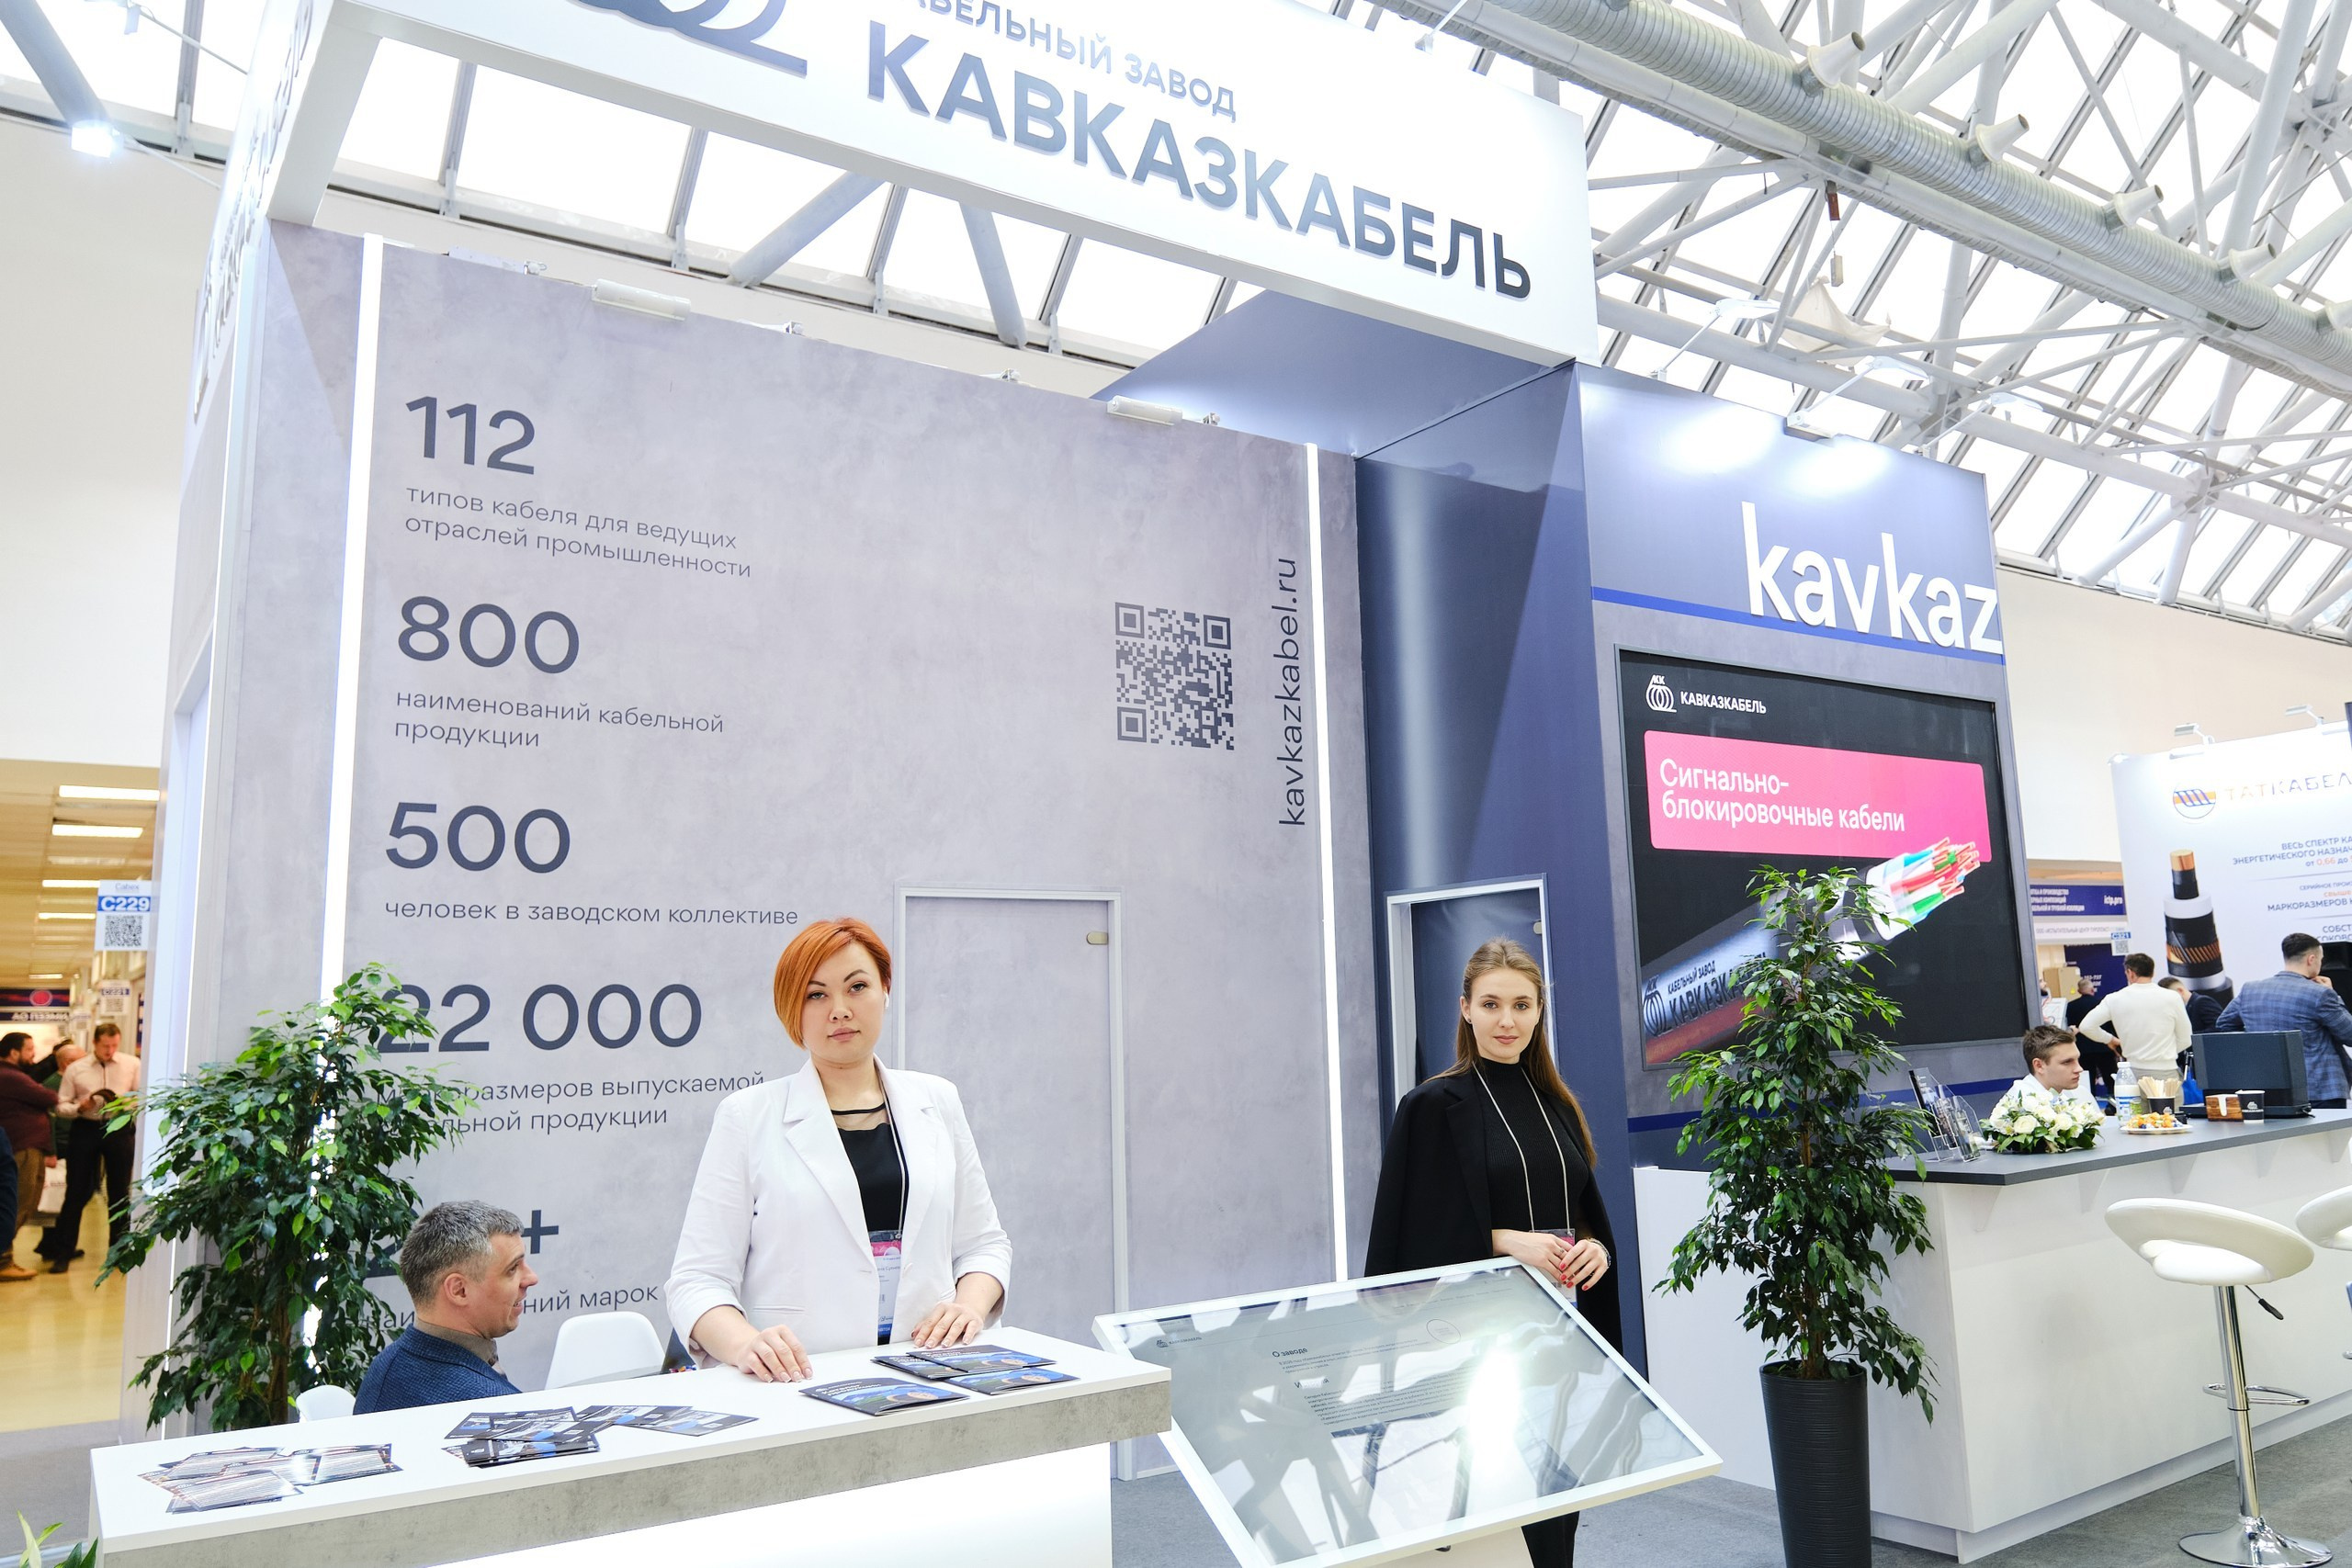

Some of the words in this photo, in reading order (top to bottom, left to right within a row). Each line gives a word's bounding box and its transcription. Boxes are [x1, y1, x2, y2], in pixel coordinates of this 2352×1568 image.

[1124, 53, 1237, 123] ЗАВОД
[867, 20, 1532, 300] КАВКАЗКАБЕЛЬ
[405, 396, 536, 475] 112
[406, 487, 483, 512] типов
[492, 500, 577, 526] кабеля
[585, 514, 628, 534] для
[637, 521, 737, 549] ведущих
[405, 515, 527, 548] отраслей
[537, 535, 752, 577] промышленности
[1742, 502, 2004, 655] kavkaz
[398, 596, 580, 674] 800
[1272, 558, 1306, 826] kavkazkabel.ru
[1680, 691, 1767, 715] КАВКАЗКАБЕЛЬ
[396, 692, 591, 722] наименований
[598, 705, 724, 733] кабельной
[395, 720, 539, 748] продукции
[1659, 759, 1789, 795] Сигнально-
[1662, 791, 1834, 833] блокировочные
[1838, 803, 1905, 832] кабели
[386, 802, 571, 874] 500
[2233, 849, 2315, 865] ЭНЕРГЕТИЧЕСКОГО
[2281, 841, 2303, 851] ВЕСЬ
[2305, 837, 2339, 848] СПЕКТР
[101, 897, 149, 910] C229
[386, 902, 497, 919] человек
[506, 904, 519, 919] в
[528, 906, 661, 925] заводском
[668, 907, 798, 925] коллективе
[2267, 897, 2348, 911] МАРКОРАЗМЕРОВ
[1668, 967, 1698, 995] КАБЕЛЬНЫЙ
[1698, 961, 1716, 979] ЗАВОД
[378, 984, 491, 1054] 22
[523, 984, 701, 1051] 000
[377, 1080, 593, 1105] мкразмеров
[602, 1071, 764, 1100] выпускаемой
[530, 1108, 668, 1135] продукции
[580, 1286, 658, 1309] марок
